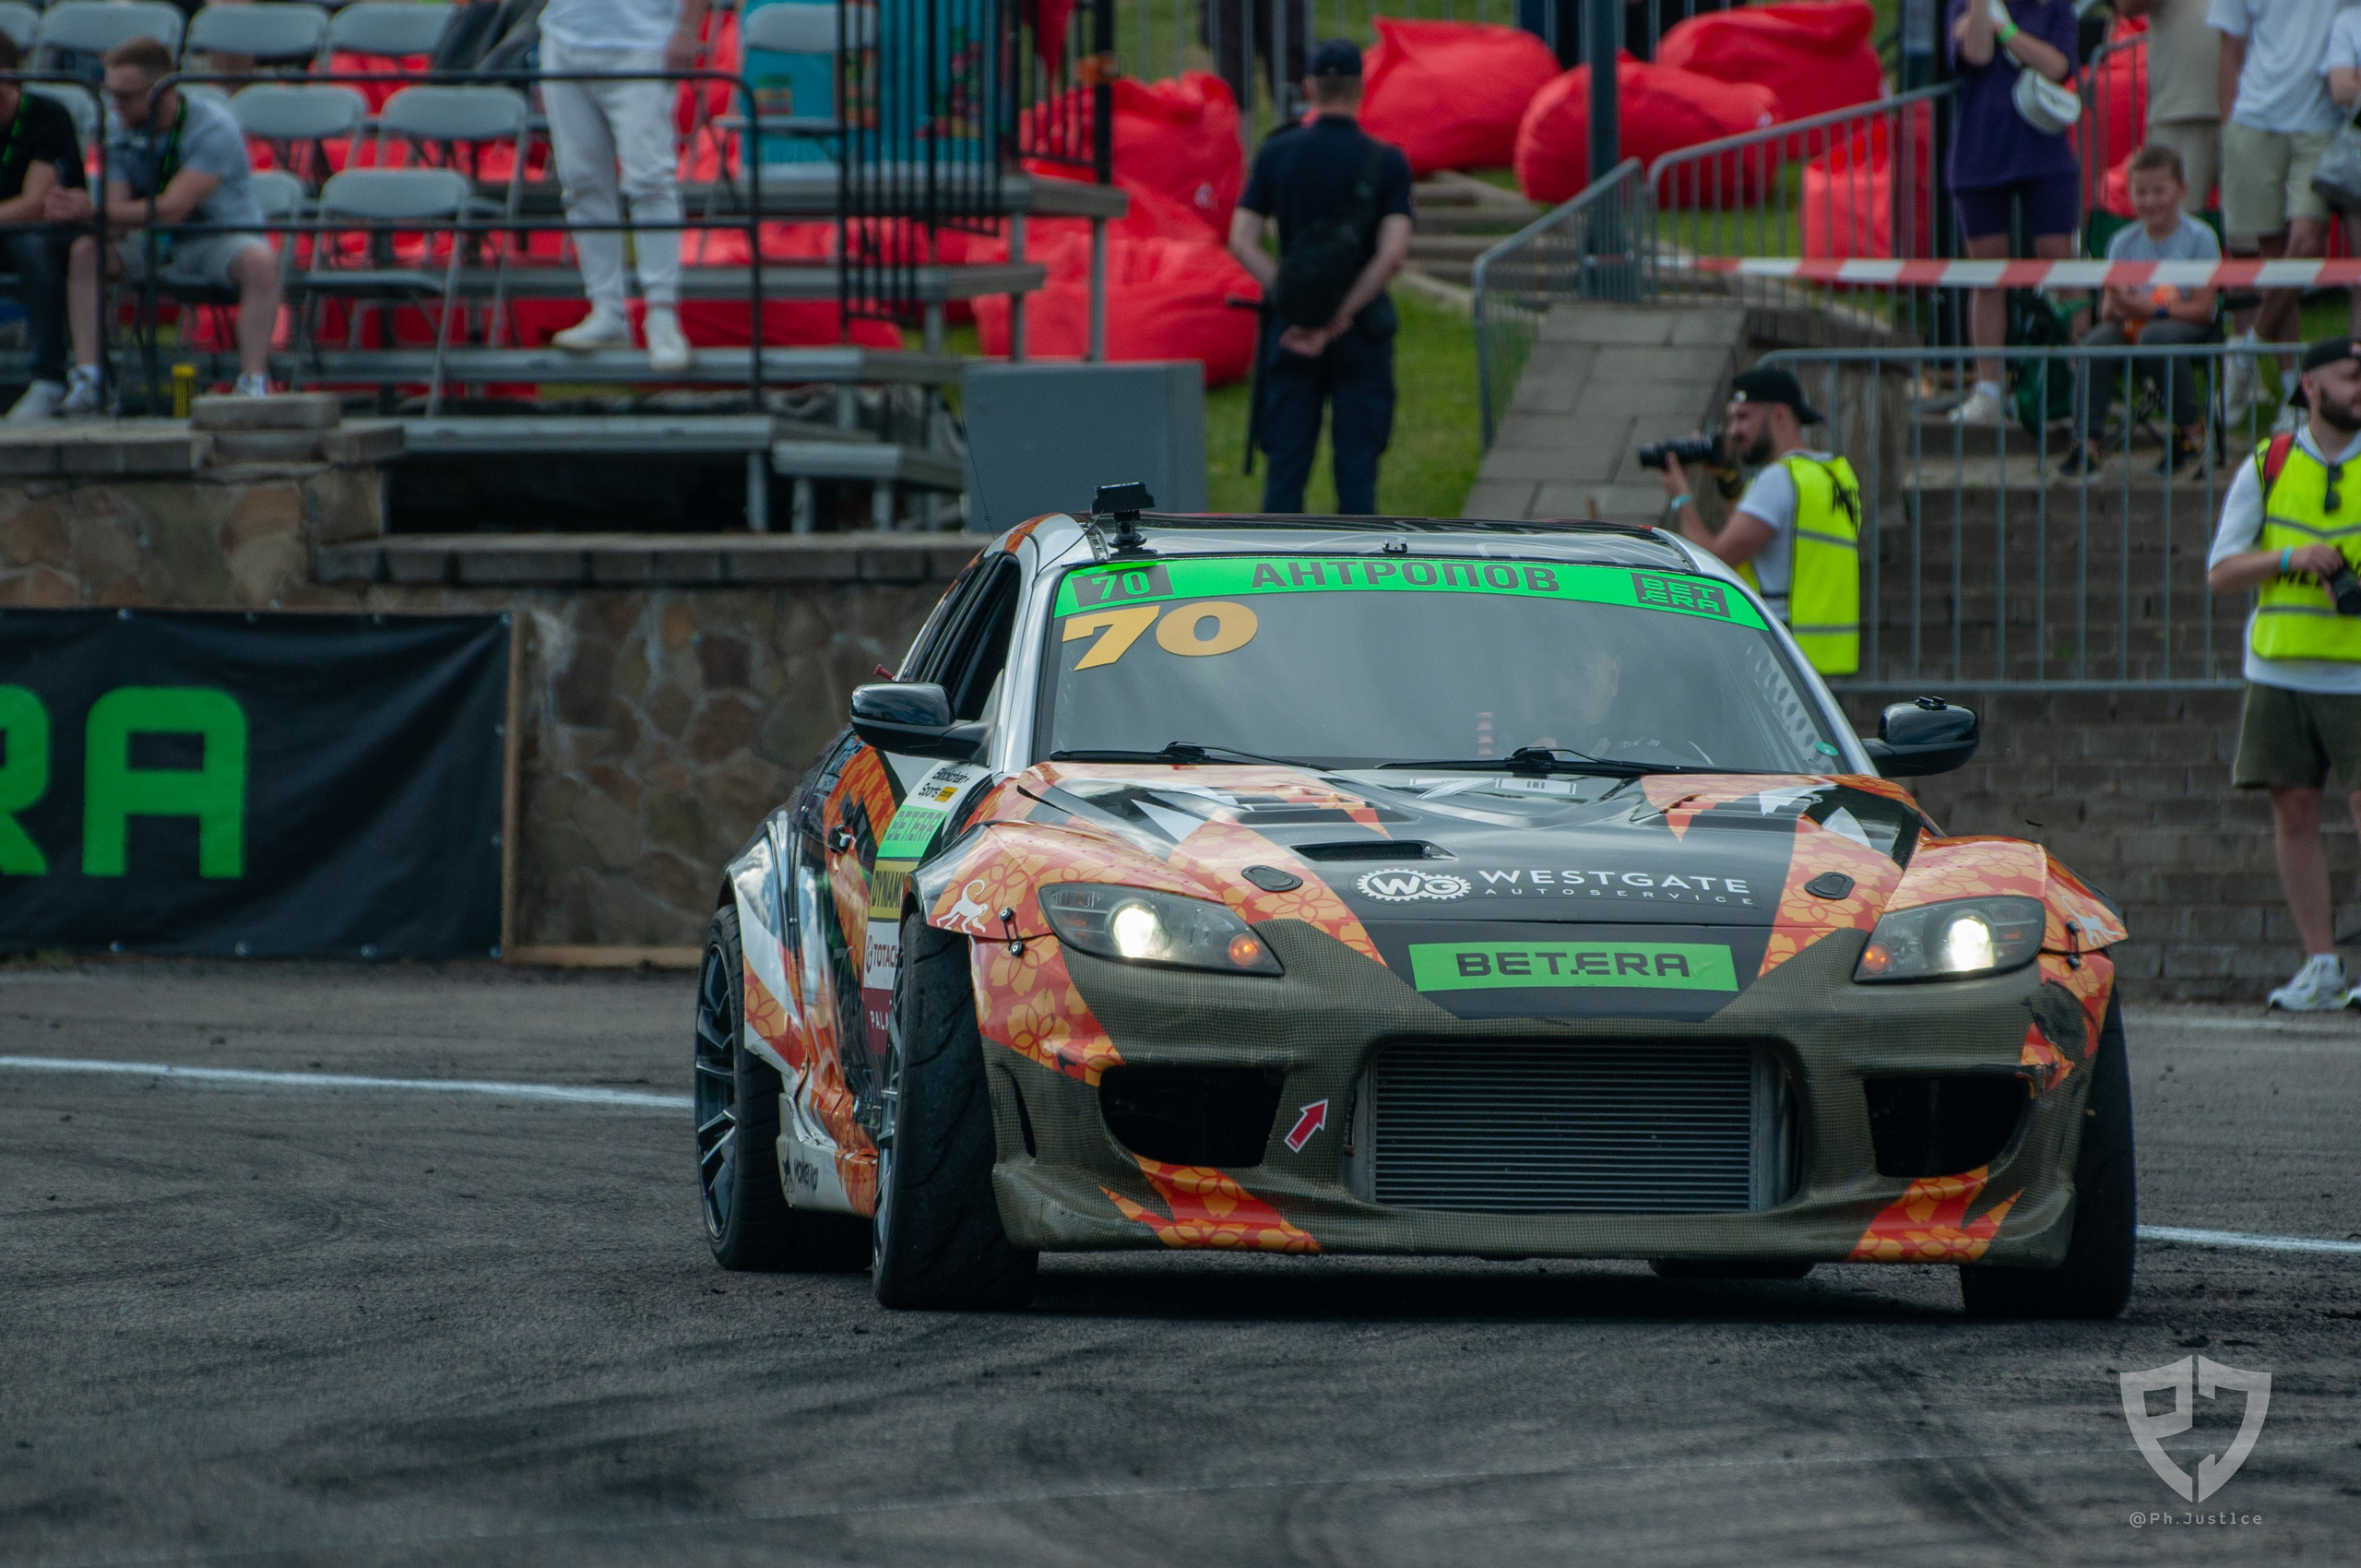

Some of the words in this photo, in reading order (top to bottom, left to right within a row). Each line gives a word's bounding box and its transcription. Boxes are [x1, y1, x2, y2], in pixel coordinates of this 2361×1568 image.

[1091, 571, 1150, 600] 70
[1252, 561, 1560, 592] АНТРОПОВ
[1642, 576, 1715, 599] BET
[1062, 600, 1259, 672] 70
[1477, 870, 1750, 894] WESTGATE
[1484, 888, 1754, 905] AUTOSERVICE
